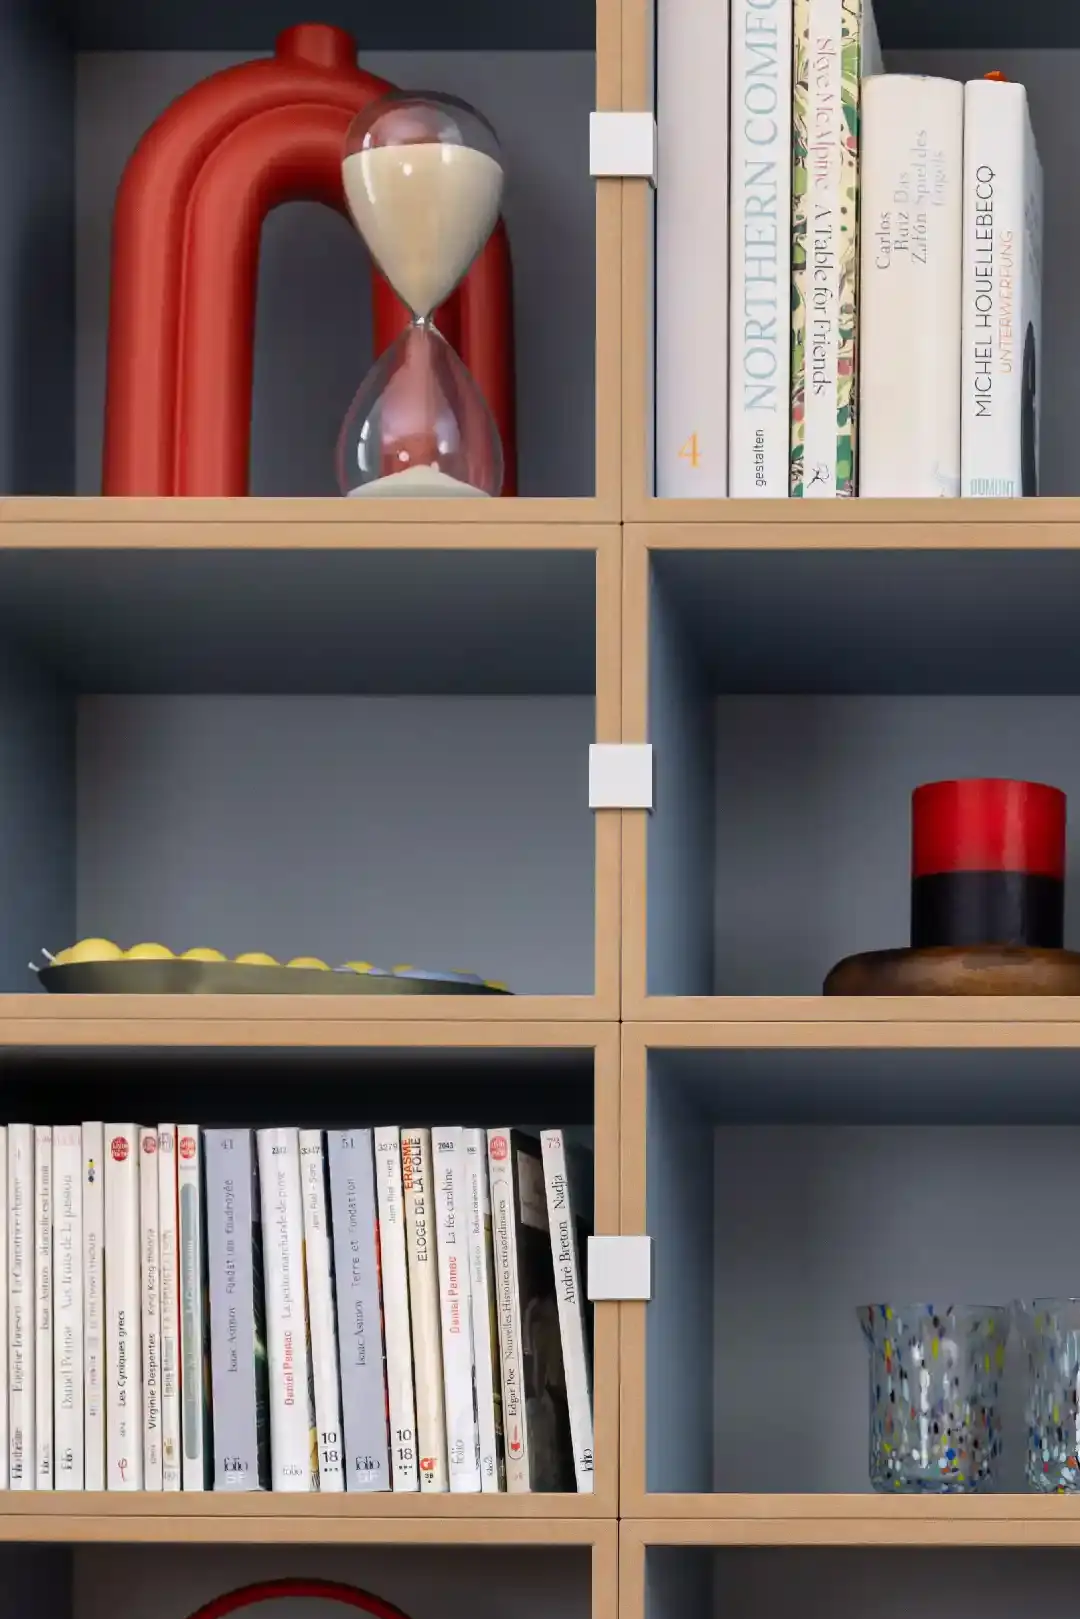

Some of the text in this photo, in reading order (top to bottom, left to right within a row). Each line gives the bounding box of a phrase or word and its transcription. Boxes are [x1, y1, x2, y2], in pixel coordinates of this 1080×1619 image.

[810, 38, 837, 396] Skye McAlpine A Table for Friends
[894, 211, 910, 251] Ruiz
[874, 211, 892, 270] Carlos
[743, 159, 779, 413] NORTHERN
[974, 165, 996, 417] MICHEL HOUELLEBECQ
[999, 230, 1013, 374] UNTERWERFUNG
[753, 429, 767, 487] gestalten
[402, 1138, 414, 1189] ERASME
[410, 1138, 428, 1262] ELOGE DE LA FOLIE
[350, 1240, 360, 1252] et
[441, 1168, 460, 1334] Daniel Pennac La fée carabine
[552, 1174, 576, 1304] André Breton Nadja
[500, 1270, 512, 1312] Histoires
[351, 1300, 365, 1338] Asimov
[503, 1314, 514, 1360] Nouvelles
[117, 1310, 128, 1407] Les Cyniques grecs
[147, 1333, 158, 1386] Despentes
[282, 1331, 293, 1370] Pennac
[354, 1340, 366, 1366] Isaac
[283, 1373, 294, 1406] Daniel
[506, 1368, 516, 1386] Poe
[147, 1390, 159, 1430] Virginie
[508, 1389, 520, 1416] Edgar
[321, 1432, 337, 1444] 10
[397, 1429, 412, 1441] 10
[398, 1448, 413, 1461] 18
[451, 1439, 465, 1464] folio
[322, 1450, 339, 1463] 18
[355, 1455, 380, 1471] folio
